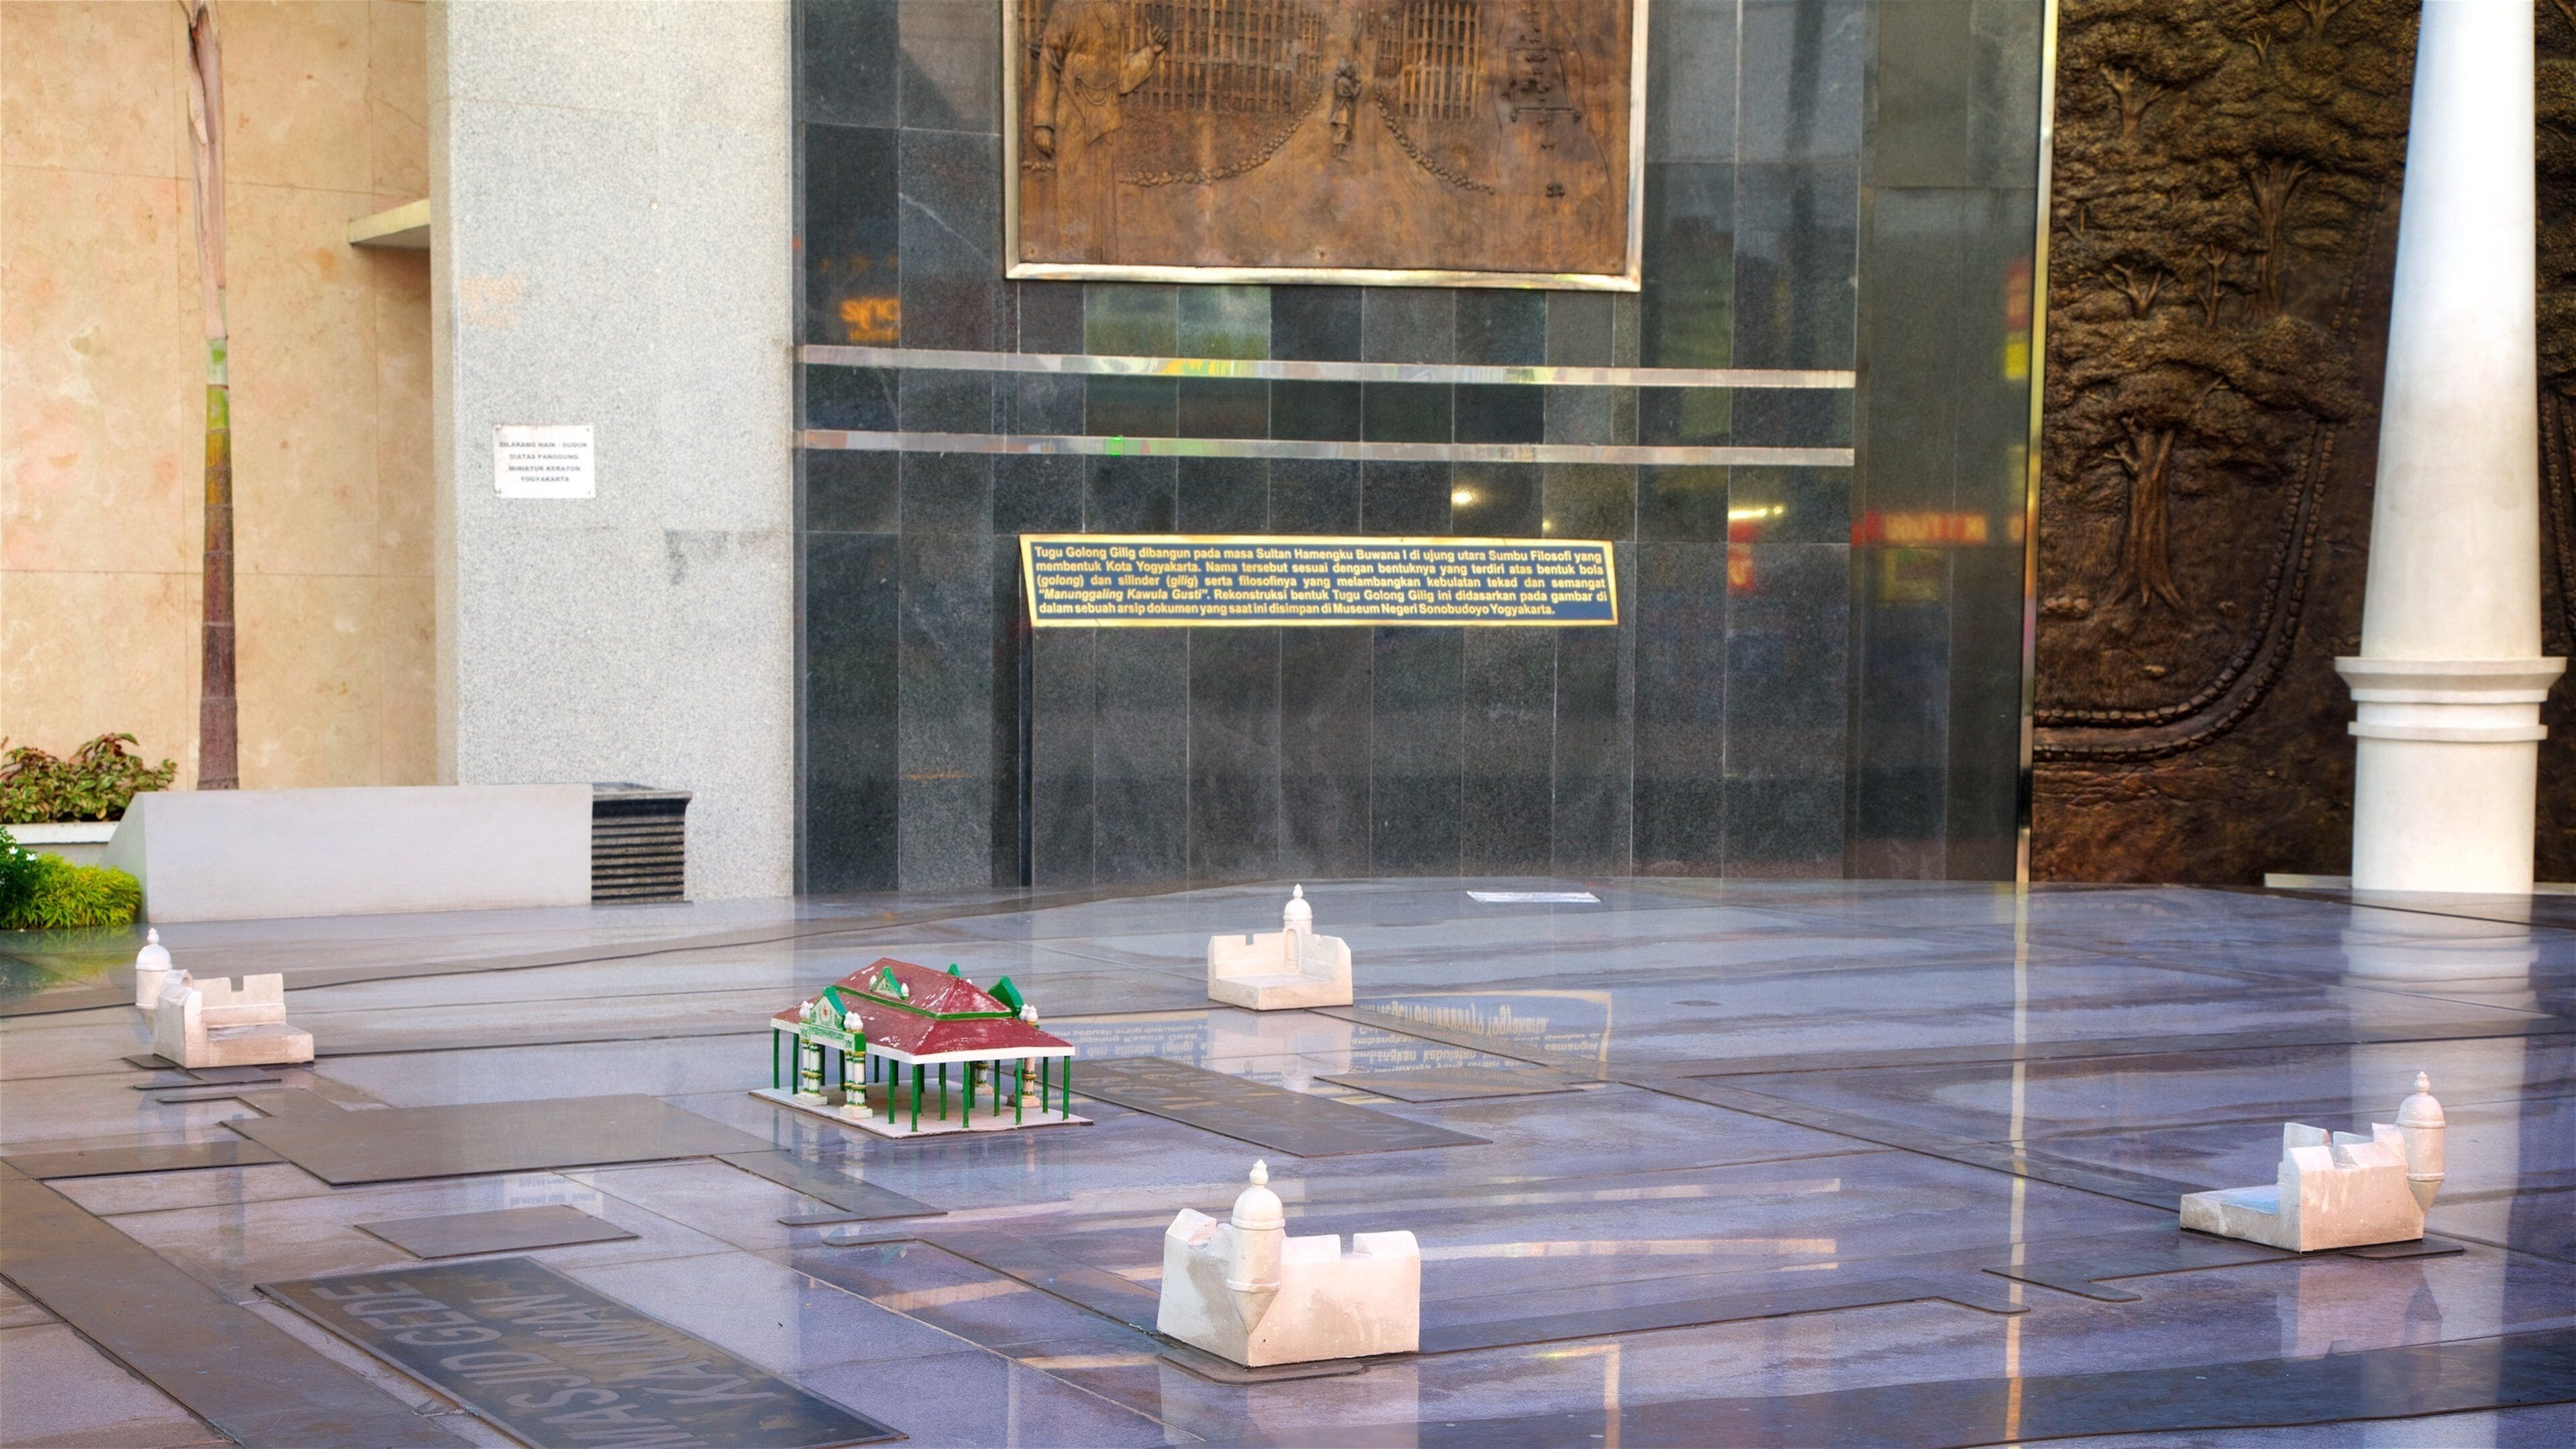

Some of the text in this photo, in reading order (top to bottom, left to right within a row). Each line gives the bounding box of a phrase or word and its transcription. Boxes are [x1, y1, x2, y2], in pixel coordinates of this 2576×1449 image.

[1034, 547, 1603, 564] Tugu Golong Gilig dibangun pada masa Sultan Hamengku Buwana I di ujung utara Sumbu Filosofi yang
[1034, 560, 1605, 576] membentuk Kota Yogyakarta. Nama tersebut sesuai dengan bentuknya yang terdiri atas bentuk bola
[1036, 575, 1607, 590] (golong) dan silinder (gilig) serta filosofinya yang melambangkan kebulatan tekad dan semangat
[1126, 589, 1169, 600] Kawula
[1213, 589, 1288, 600] Rekonstruksi
[1289, 589, 1329, 600] bentuk
[1333, 590, 1360, 603] Tugu
[1363, 590, 1405, 603] Golong
[1407, 590, 1436, 603] Gilig
[1437, 590, 1452, 601] ini
[1454, 590, 1517, 601] didasarkan
[1519, 590, 1548, 604] pada
[1550, 590, 1593, 604] gambar
[1596, 590, 1608, 601] di
[1038, 602, 1556, 616] dalam sebuah arsip dokumen yang saat ini disimpan di Museum Negeri Sonobudoyo Yogyakarta.
[309, 1282, 503, 1346] GEDE
[469, 1293, 778, 1403] KAUMAN
